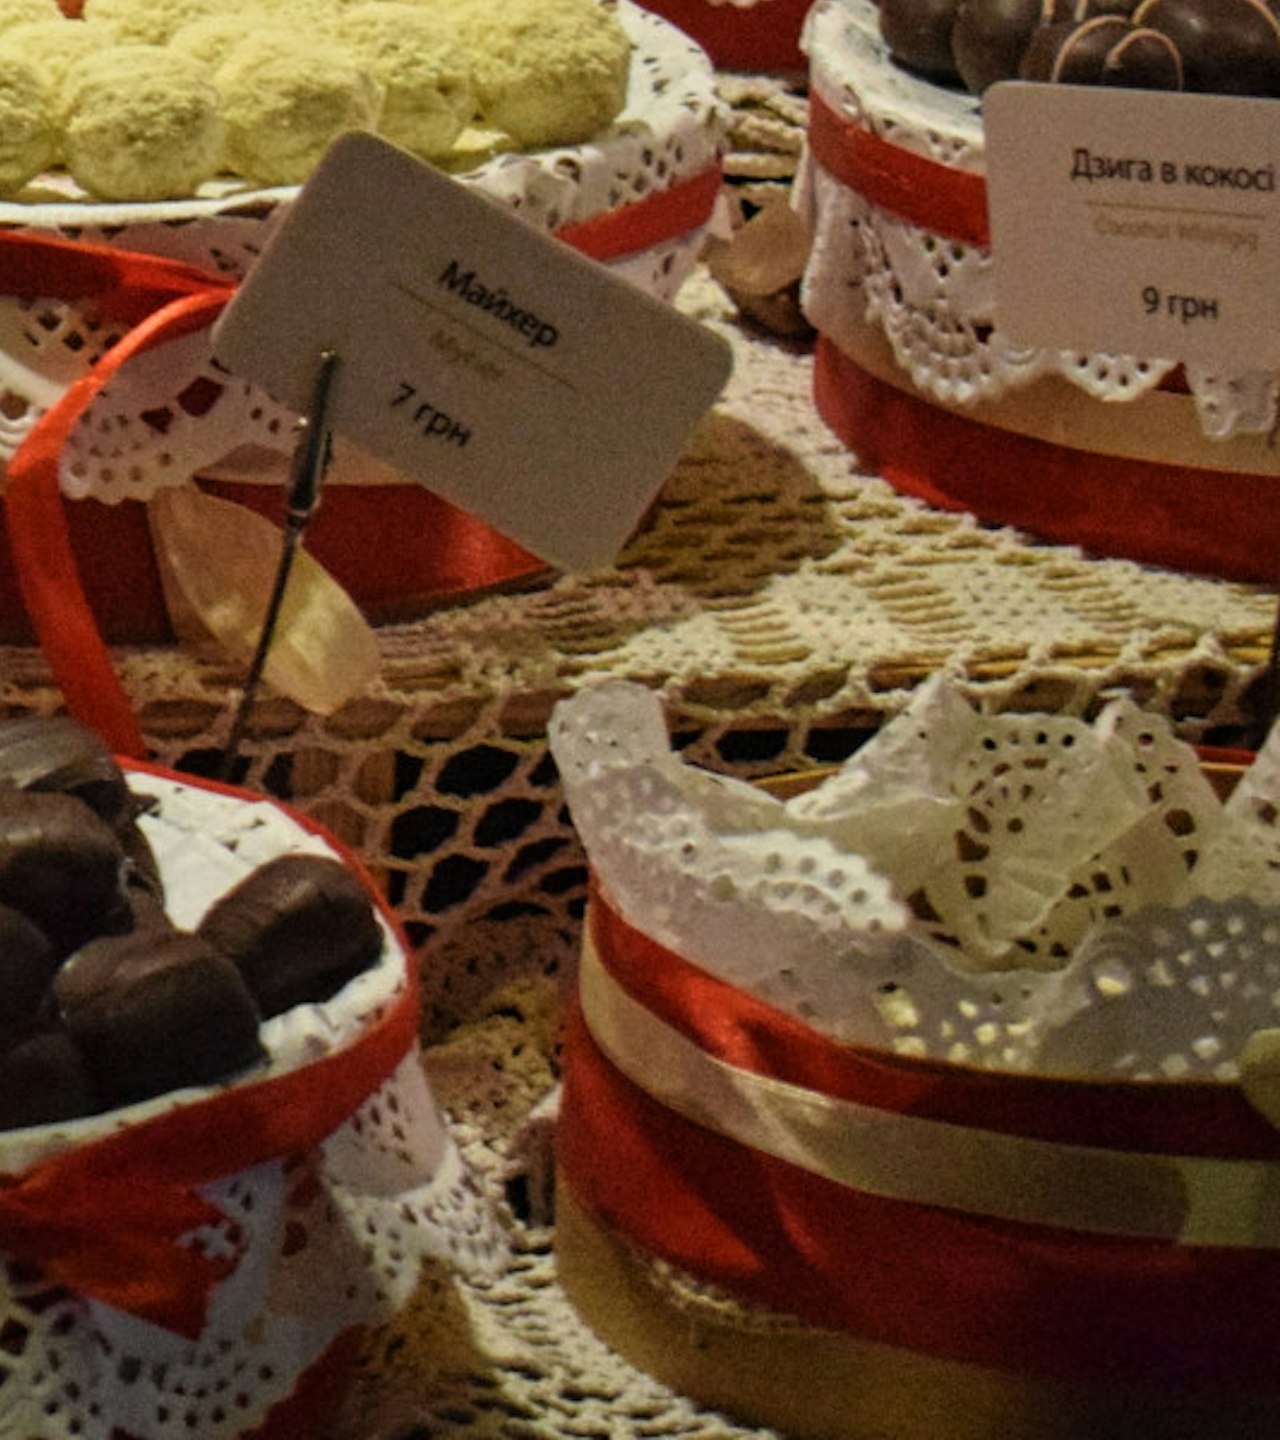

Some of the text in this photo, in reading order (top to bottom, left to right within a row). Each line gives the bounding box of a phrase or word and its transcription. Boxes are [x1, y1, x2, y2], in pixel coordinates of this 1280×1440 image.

[1069, 148, 1276, 192] Дзига в кокосі
[439, 261, 558, 348] Майхер
[1142, 285, 1219, 324] 9 грн
[389, 382, 473, 447] 7 грн
